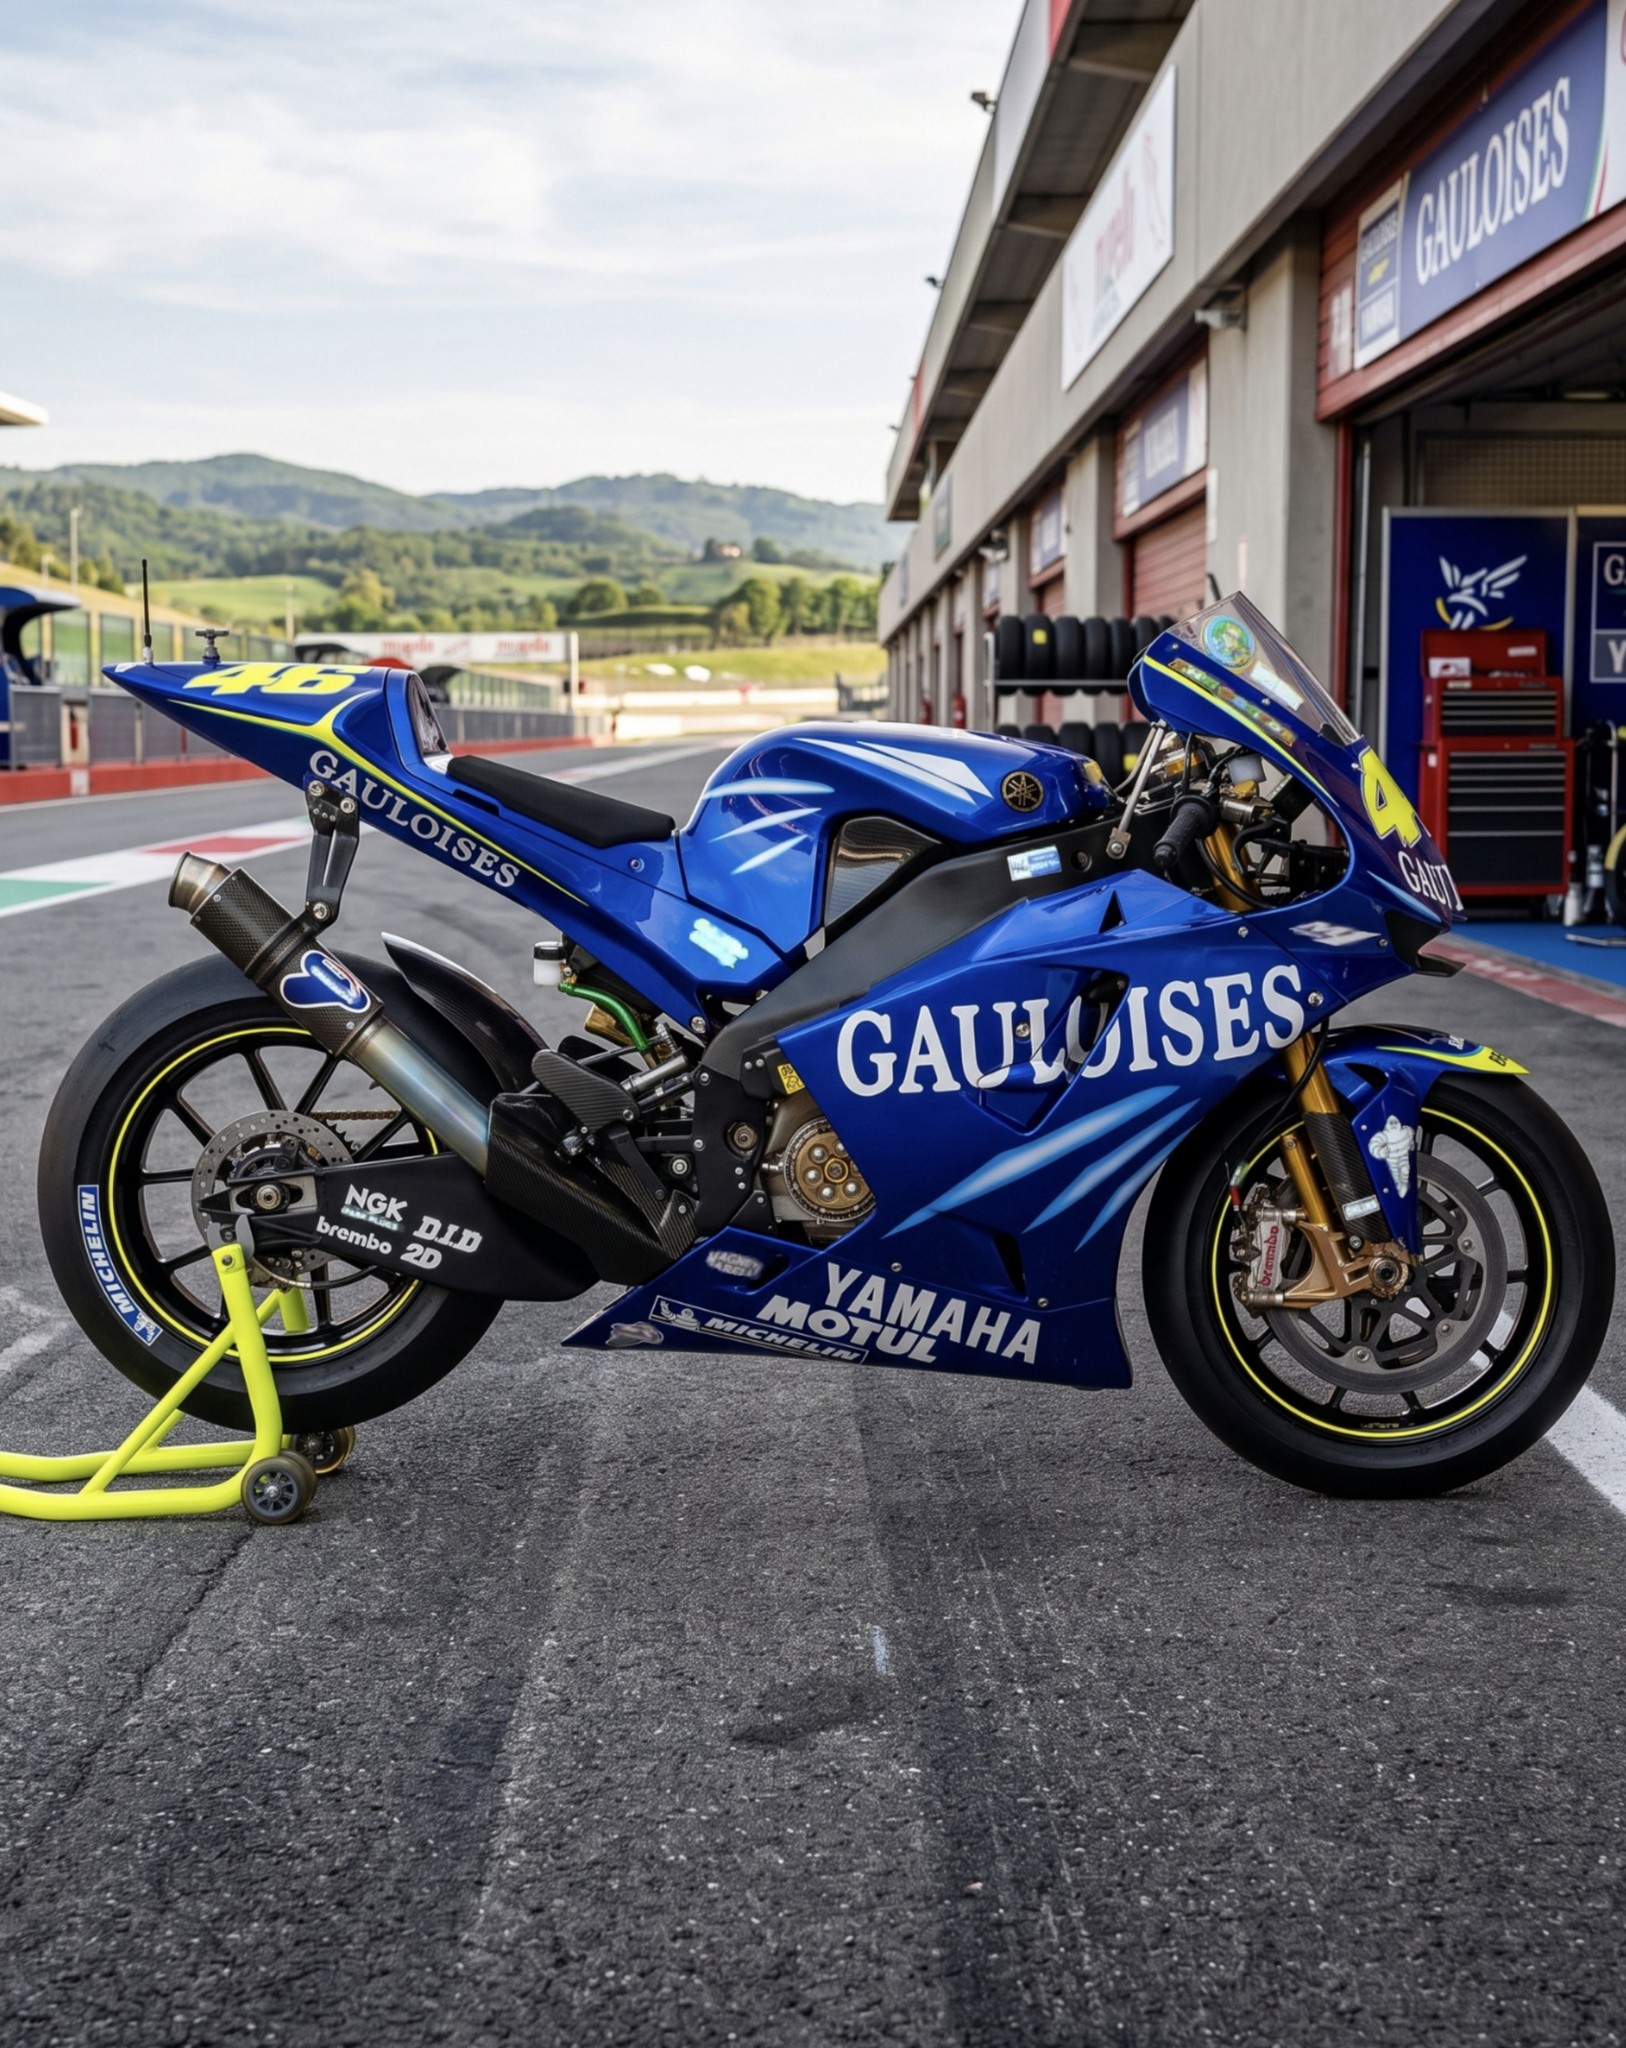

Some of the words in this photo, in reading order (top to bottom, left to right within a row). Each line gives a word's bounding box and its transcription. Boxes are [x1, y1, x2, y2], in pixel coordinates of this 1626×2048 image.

[1416, 76, 1570, 285] GAULOISES
[1603, 553, 1626, 586] G
[182, 663, 374, 695] 46
[309, 750, 520, 888] GAULOISES
[837, 965, 1305, 1097] GAULOISES
[345, 1184, 408, 1222] NGK
[81, 1191, 135, 1314] MICHELIN
[316, 1216, 392, 1255] brembo
[400, 1243, 442, 1270] 2D
[704, 1317, 862, 1361] MICHELIN
[756, 1294, 937, 1363] MOTUL
[825, 1262, 1041, 1364] YAMAHA
